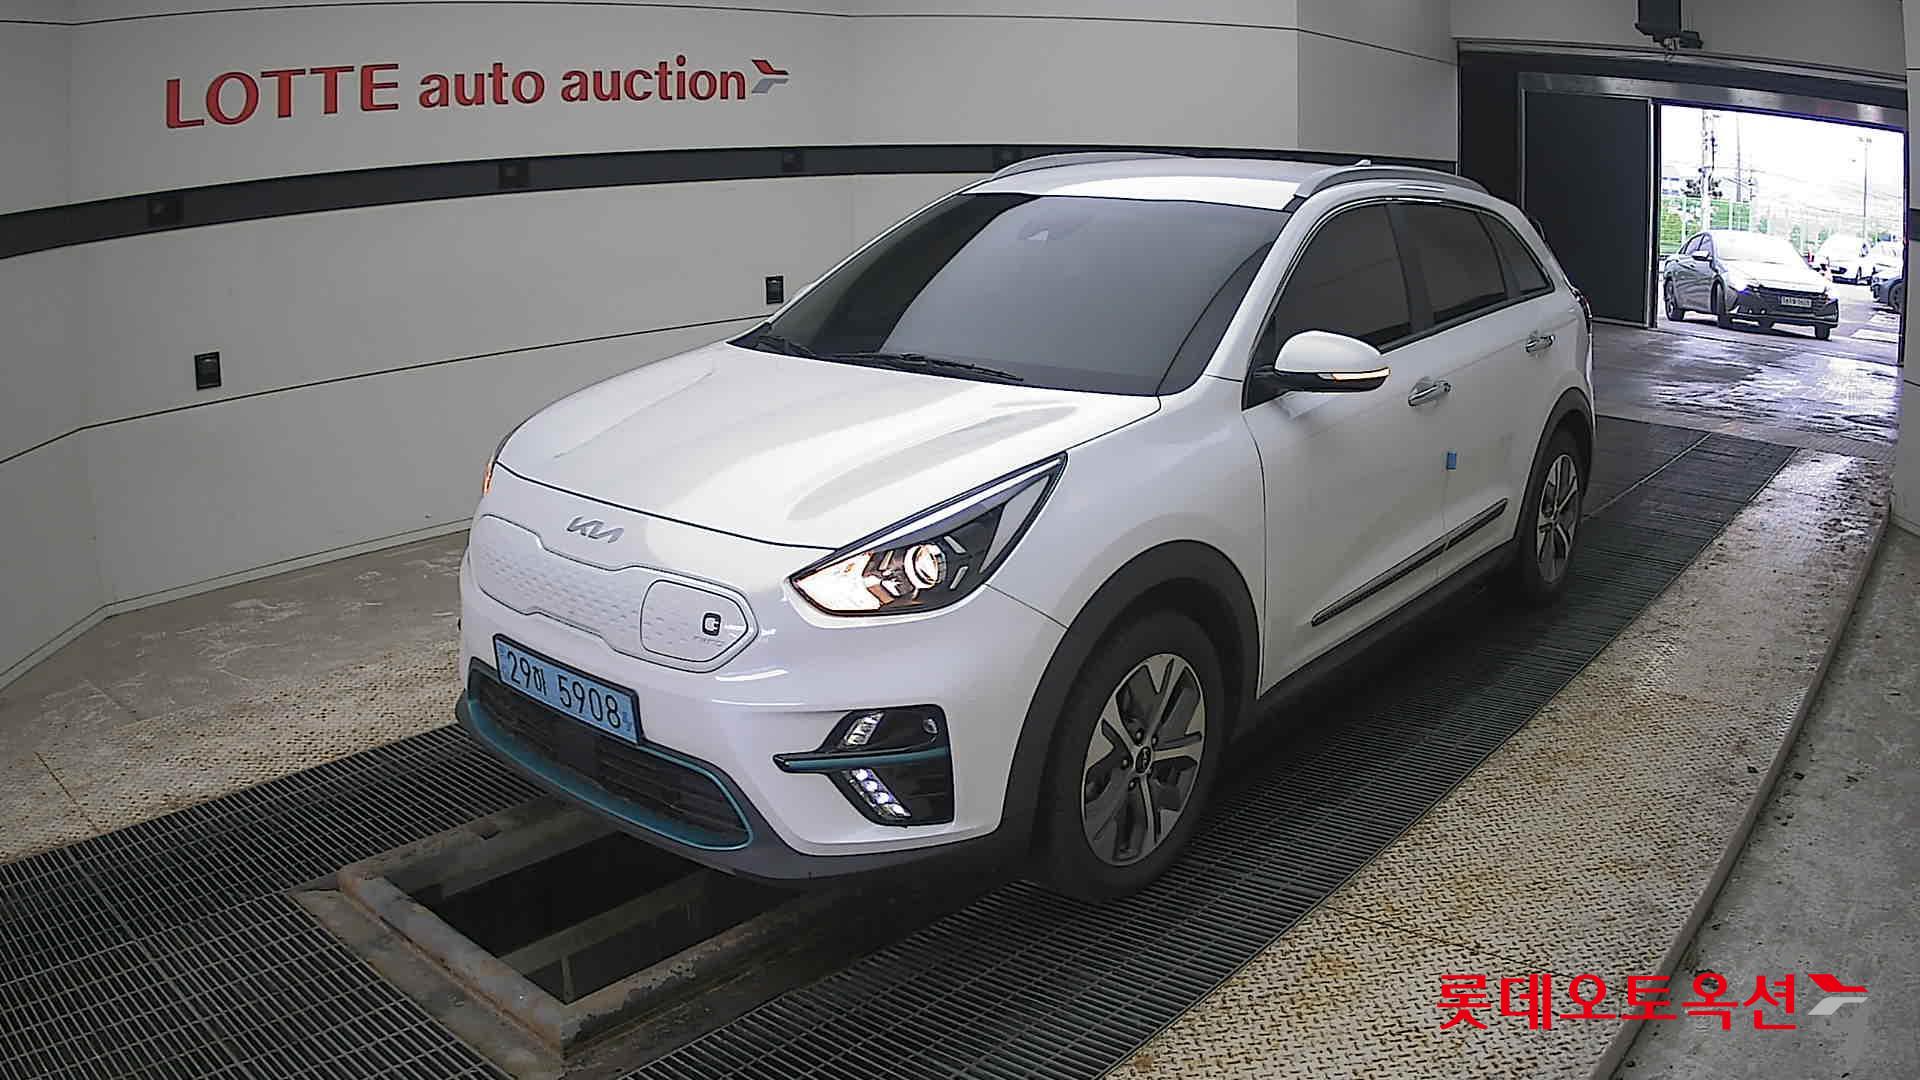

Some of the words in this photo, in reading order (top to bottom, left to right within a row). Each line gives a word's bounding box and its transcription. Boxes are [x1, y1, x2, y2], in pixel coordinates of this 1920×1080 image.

[165, 63, 400, 130] LOTTE
[418, 62, 546, 109] auto
[561, 54, 747, 102] auction
[557, 674, 621, 729] 5908
